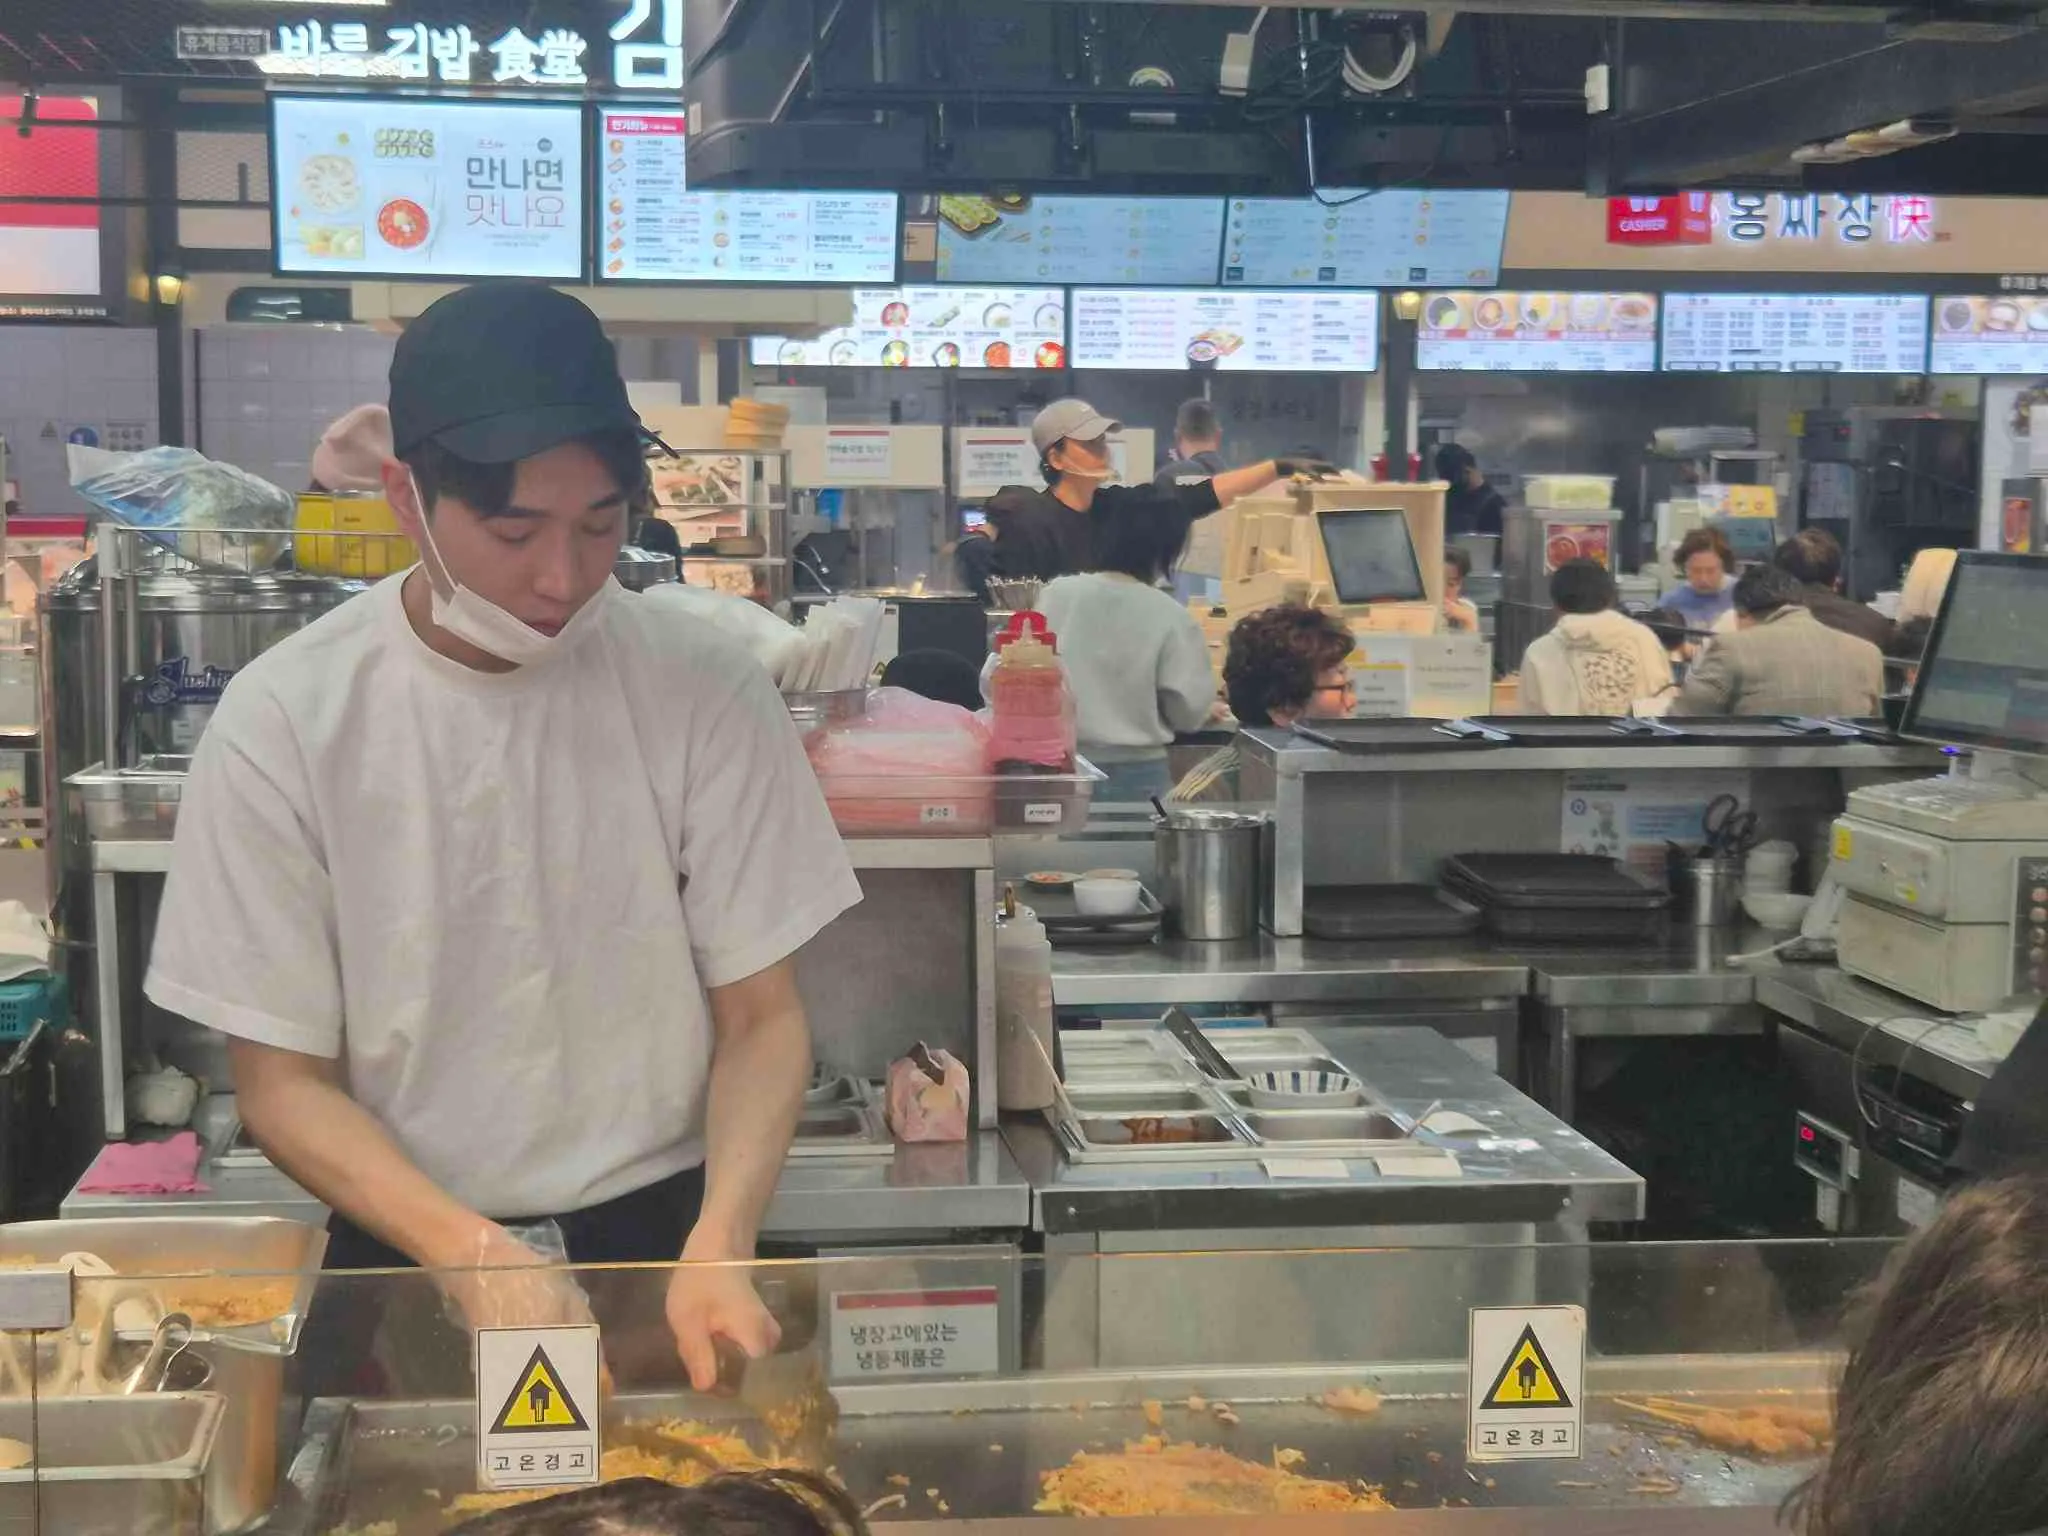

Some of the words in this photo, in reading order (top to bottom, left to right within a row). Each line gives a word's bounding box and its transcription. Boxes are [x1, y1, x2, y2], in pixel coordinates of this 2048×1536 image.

[386, 22, 480, 81] 김밥
[488, 27, 587, 84] 食堂
[466, 156, 564, 191] 만나면
[466, 194, 565, 228] 맛나요
